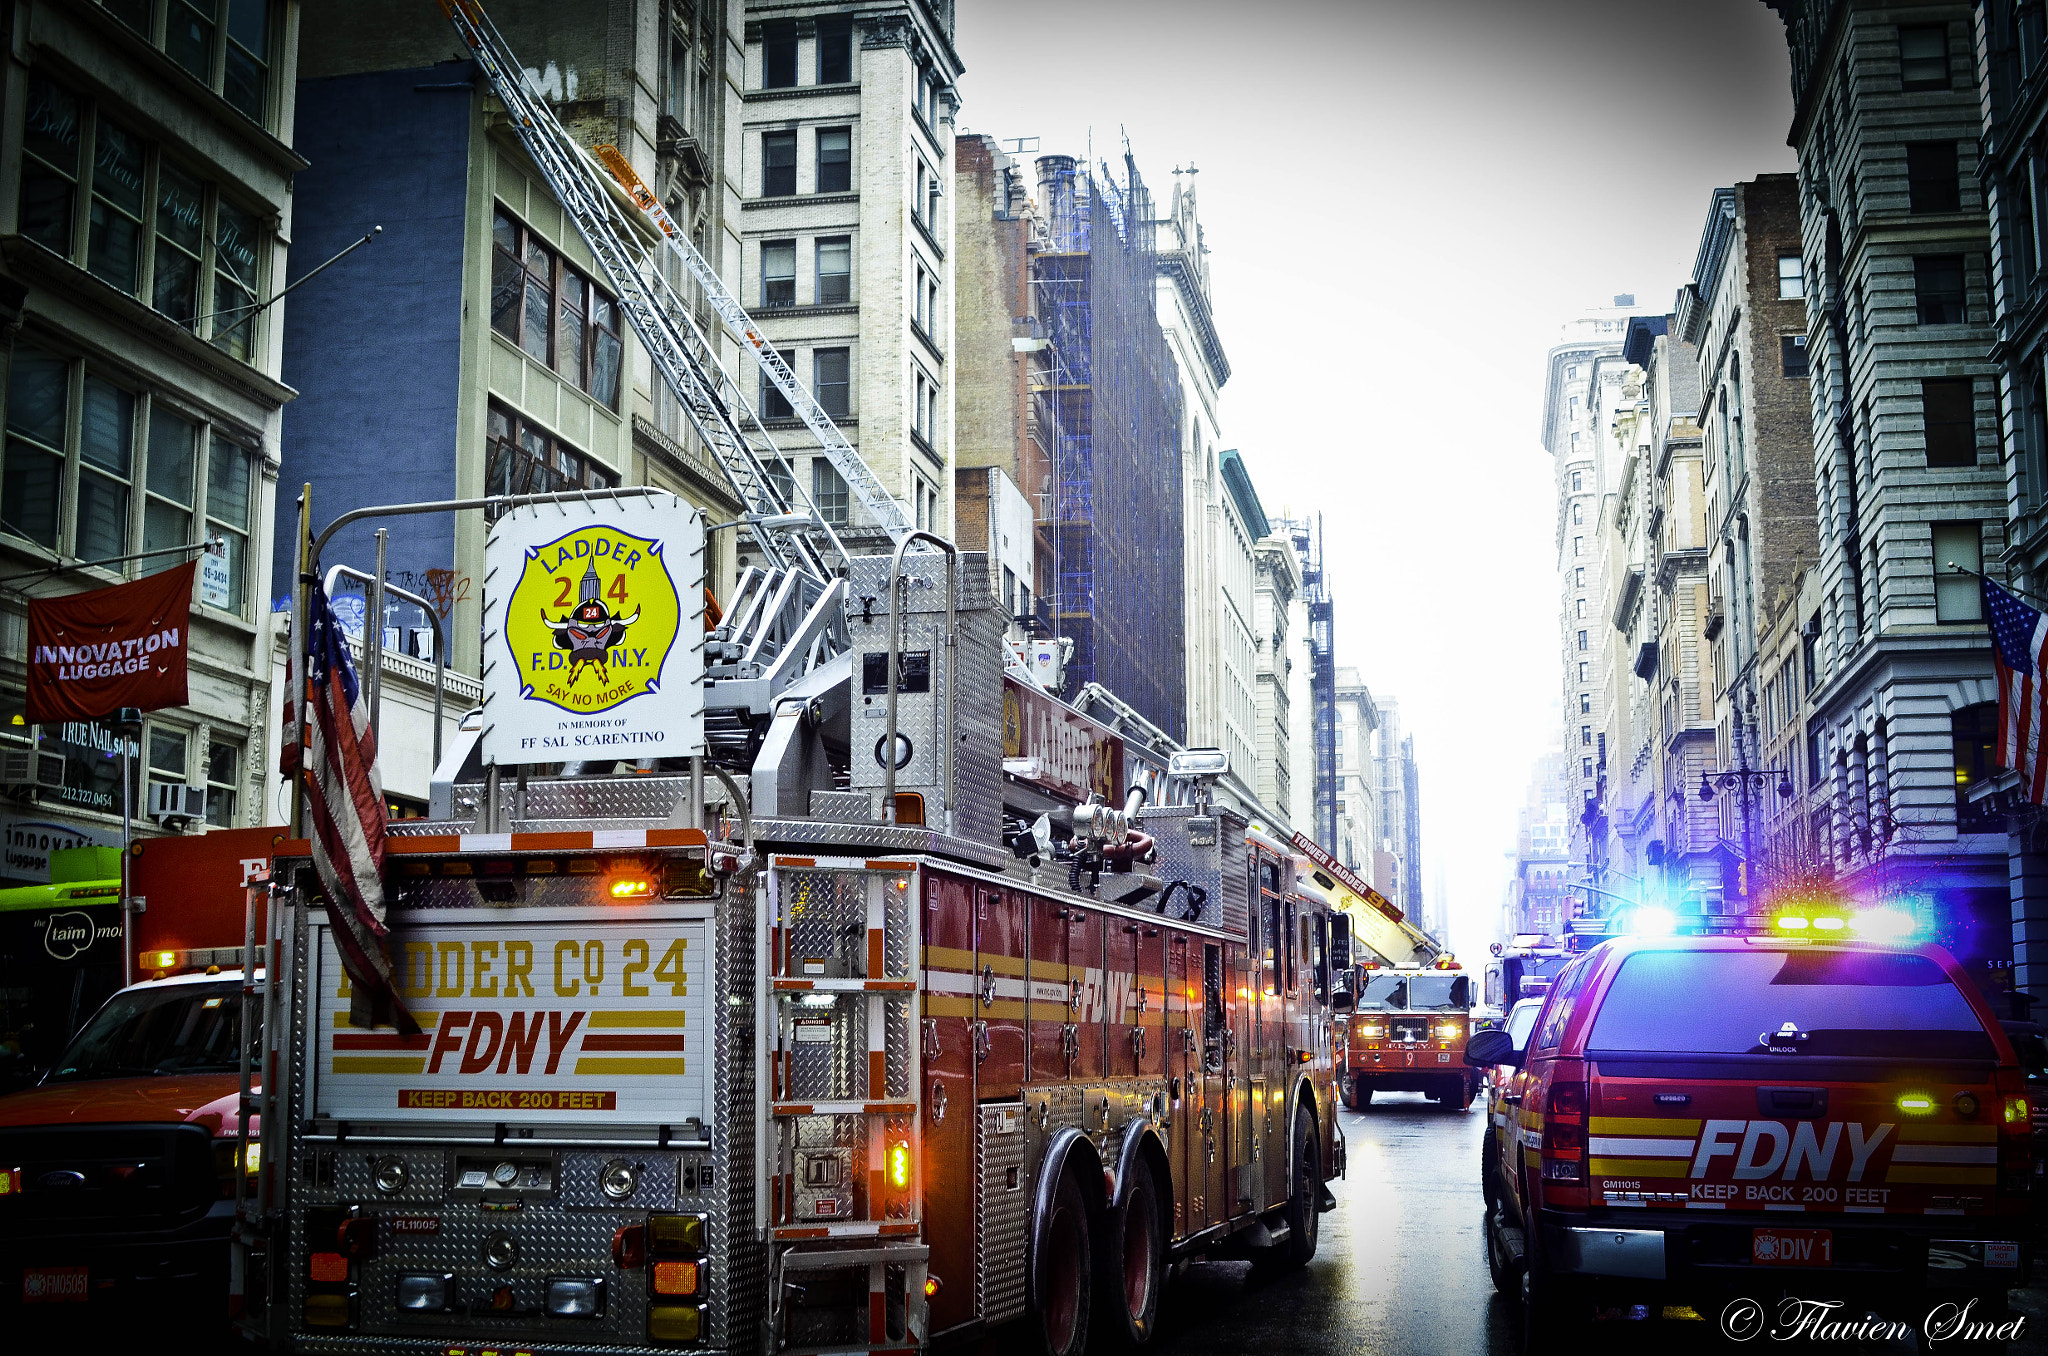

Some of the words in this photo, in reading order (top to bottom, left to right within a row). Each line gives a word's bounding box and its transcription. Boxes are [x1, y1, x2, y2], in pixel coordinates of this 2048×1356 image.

[27, 99, 79, 147] Belle
[99, 140, 143, 191] Fleur
[160, 187, 201, 230] Belle
[219, 219, 257, 266] Fleur
[541, 538, 641, 575] LADDER
[585, 608, 598, 618] 24
[34, 627, 180, 664] INNOVATION
[58, 655, 150, 680] LUGGAGE
[532, 652, 568, 672] F.D.
[612, 648, 650, 668] N.Y.
[546, 683, 570, 702] SAY
[572, 693, 592, 706] NO
[596, 680, 635, 704] MORE
[558, 721, 568, 730] IN
[570, 719, 612, 730] MEMORY
[614, 718, 628, 728] OF
[61, 721, 88, 747] TRUE
[88, 721, 113, 752] NAIL
[113, 736, 139, 758] SAON
[521, 737, 537, 749] FF
[543, 736, 569, 748] SAL
[574, 730, 665, 746] SCARENTINO
[61, 785, 112, 808] 212.727.0454
[5, 823, 114, 852] innovati
[5, 849, 47, 870] Luggage
[1294, 833, 1329, 865] TOWER
[1327, 860, 1369, 895] LADDER
[1367, 891, 1386, 911] 9
[622, 938, 688, 997] 24
[1081, 967, 1133, 1025] FDNY
[427, 1011, 586, 1075] FDNY
[1769, 1046, 1797, 1054] UNLOCK
[1406, 1052, 1414, 1067] 9
[408, 1091, 457, 1108] KEEP
[462, 1091, 513, 1108] BACK
[519, 1092, 553, 1109] 200
[558, 1092, 606, 1109] FEET
[1690, 1119, 1895, 1182] FDNY
[1603, 1181, 1641, 1190] GM11015
[1603, 1190, 1690, 1203] SIERRA
[1691, 1184, 1739, 1200] KEEP
[1745, 1185, 1795, 1202] BACK
[1802, 1187, 1838, 1202] 200
[1846, 1188, 1891, 1204] FEET
[396, 1220, 436, 1230] FL11005
[1780, 1237, 1814, 1261] DIV
[1821, 1238, 1830, 1261] 1
[46, 1273, 89, 1295] FM05051
